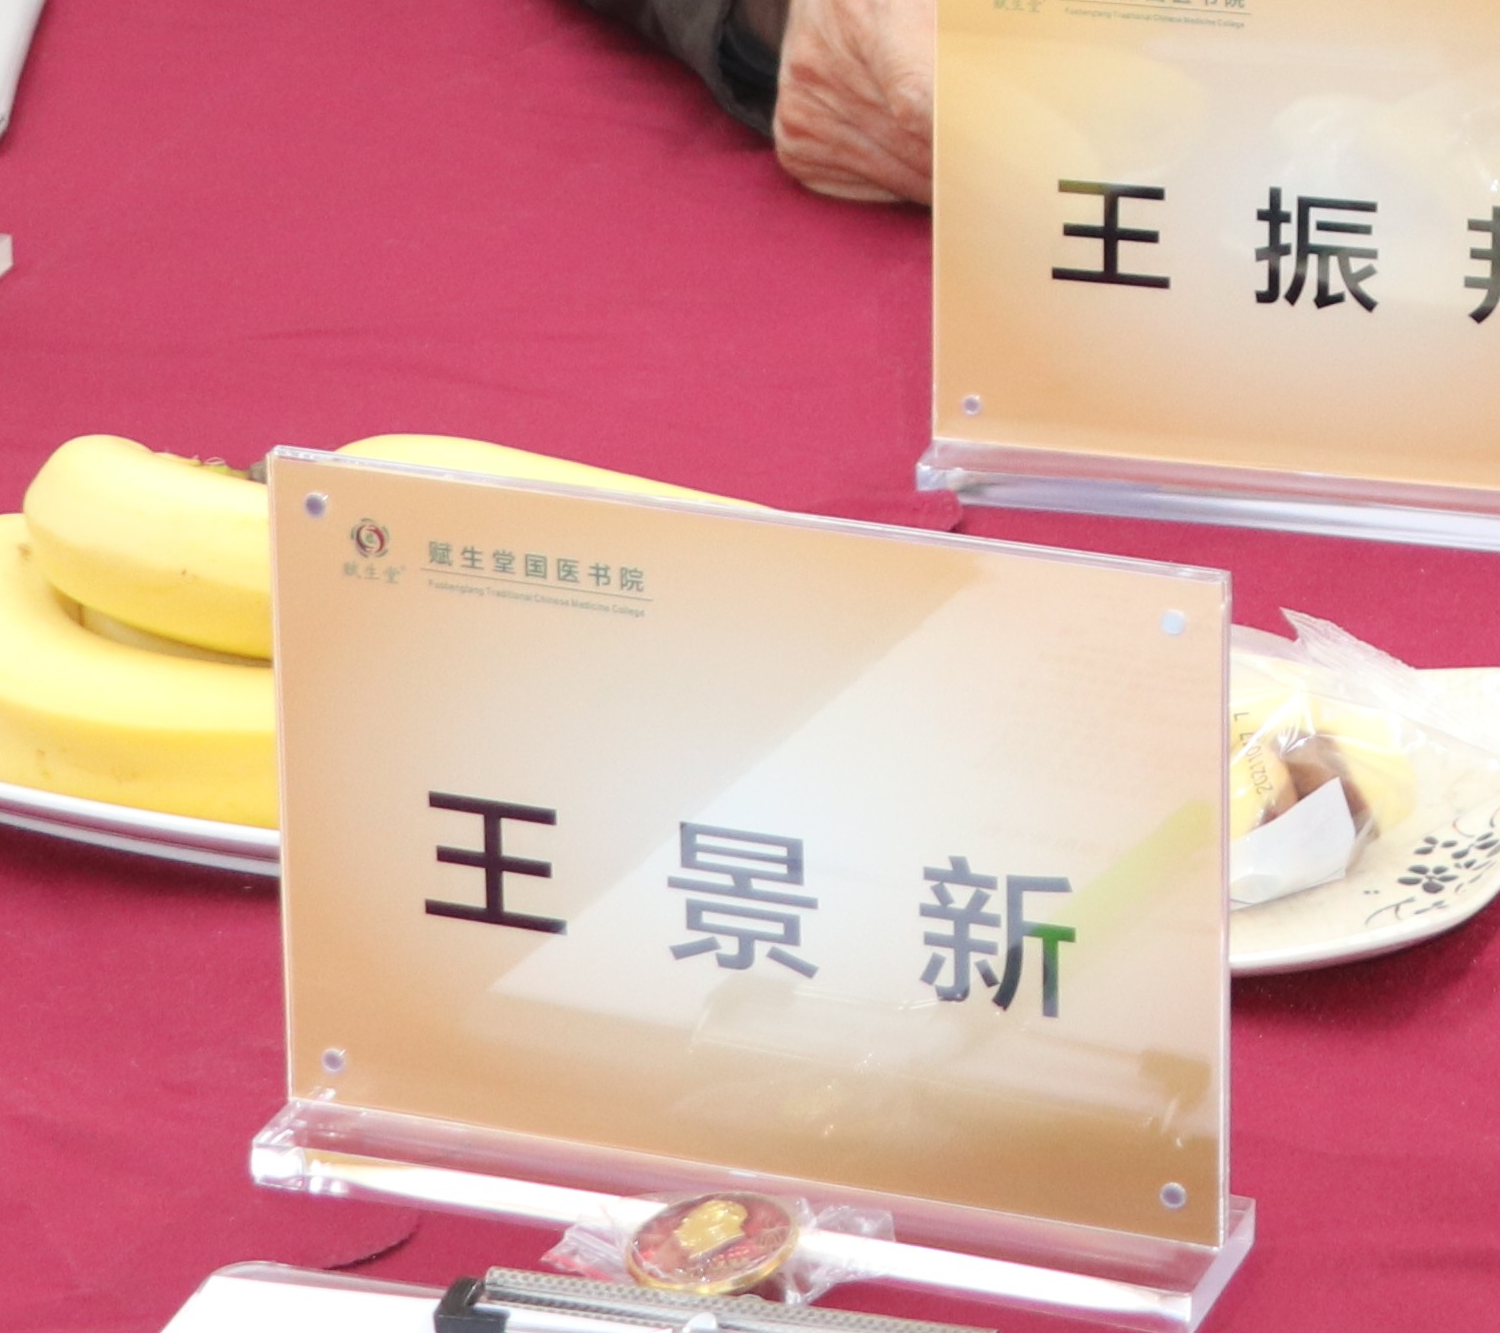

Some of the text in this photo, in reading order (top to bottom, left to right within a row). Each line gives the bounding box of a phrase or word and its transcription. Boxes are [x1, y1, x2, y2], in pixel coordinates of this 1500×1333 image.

[428, 540, 645, 592] 赋生堂国医书院
[424, 790, 1076, 1018] 王景新
